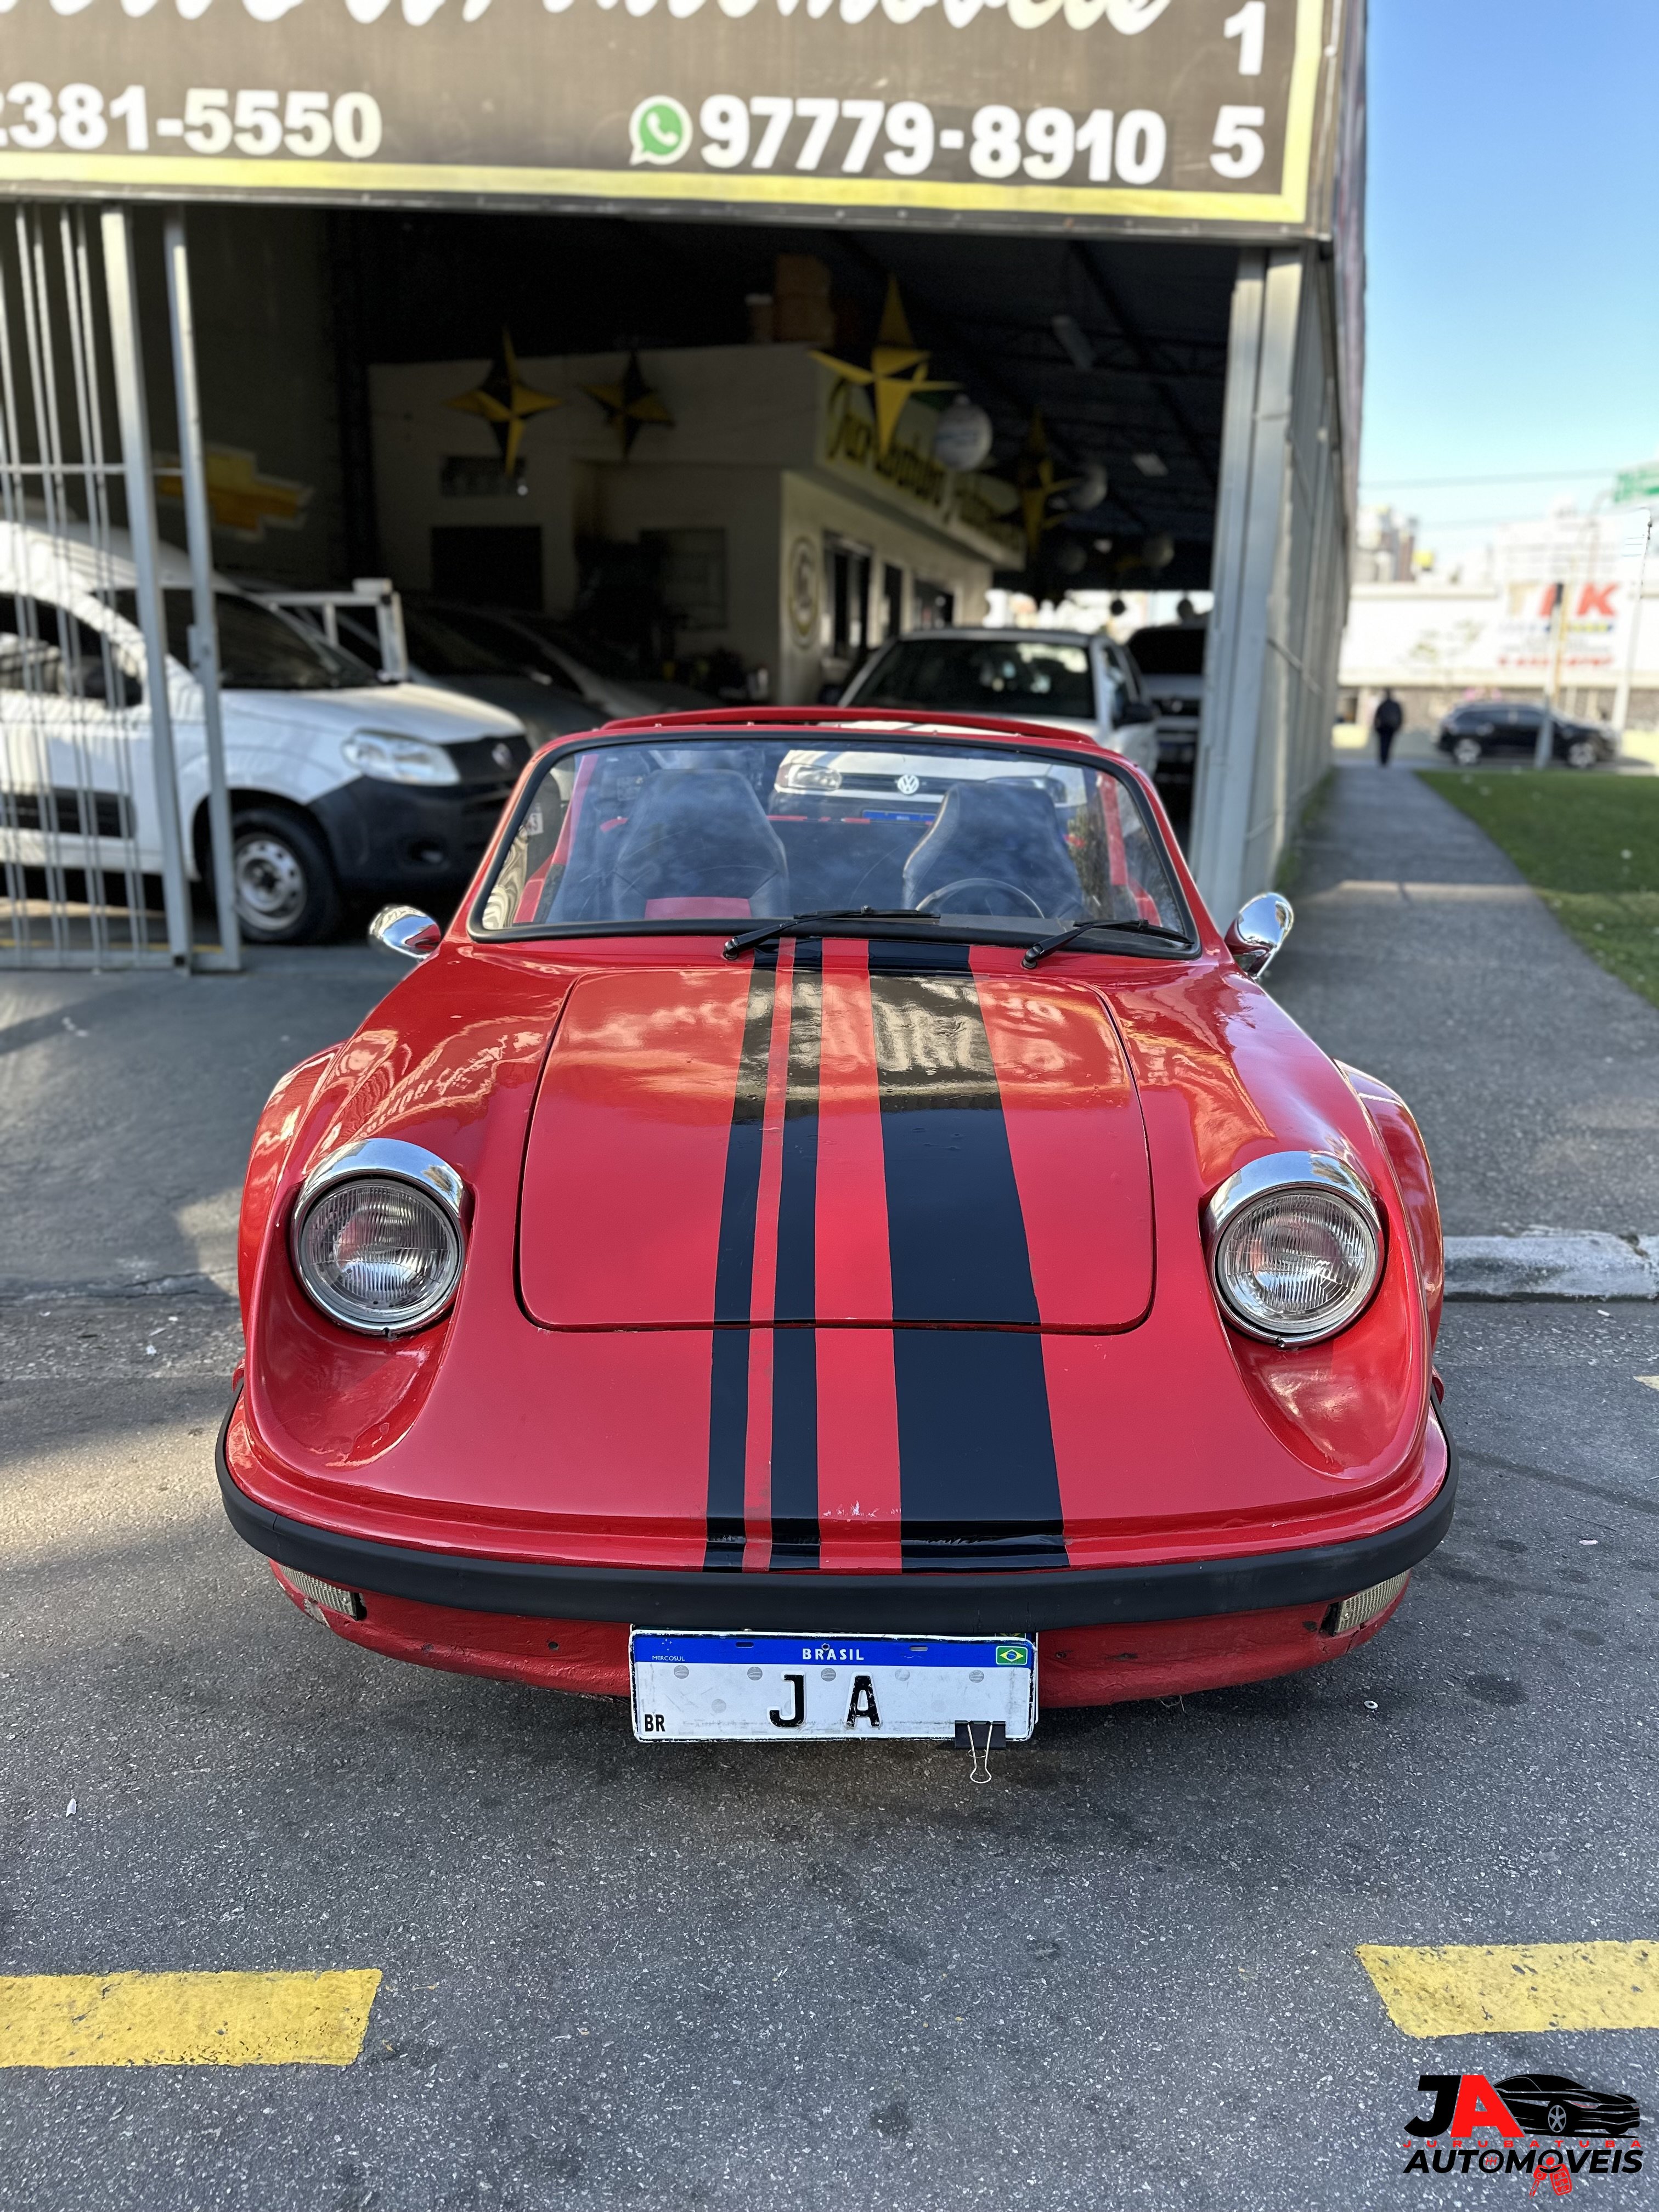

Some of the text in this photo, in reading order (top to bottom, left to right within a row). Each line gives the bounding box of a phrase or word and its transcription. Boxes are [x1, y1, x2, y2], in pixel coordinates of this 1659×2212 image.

[1224, 0, 1266, 76] 1
[0, 81, 382, 157] 381-5550
[701, 94, 1166, 184] 97779-8910
[1210, 105, 1265, 179] 5
[802, 1647, 865, 1661] BRASIL
[644, 1713, 666, 1733] BR
[769, 1674, 881, 1728] J A
